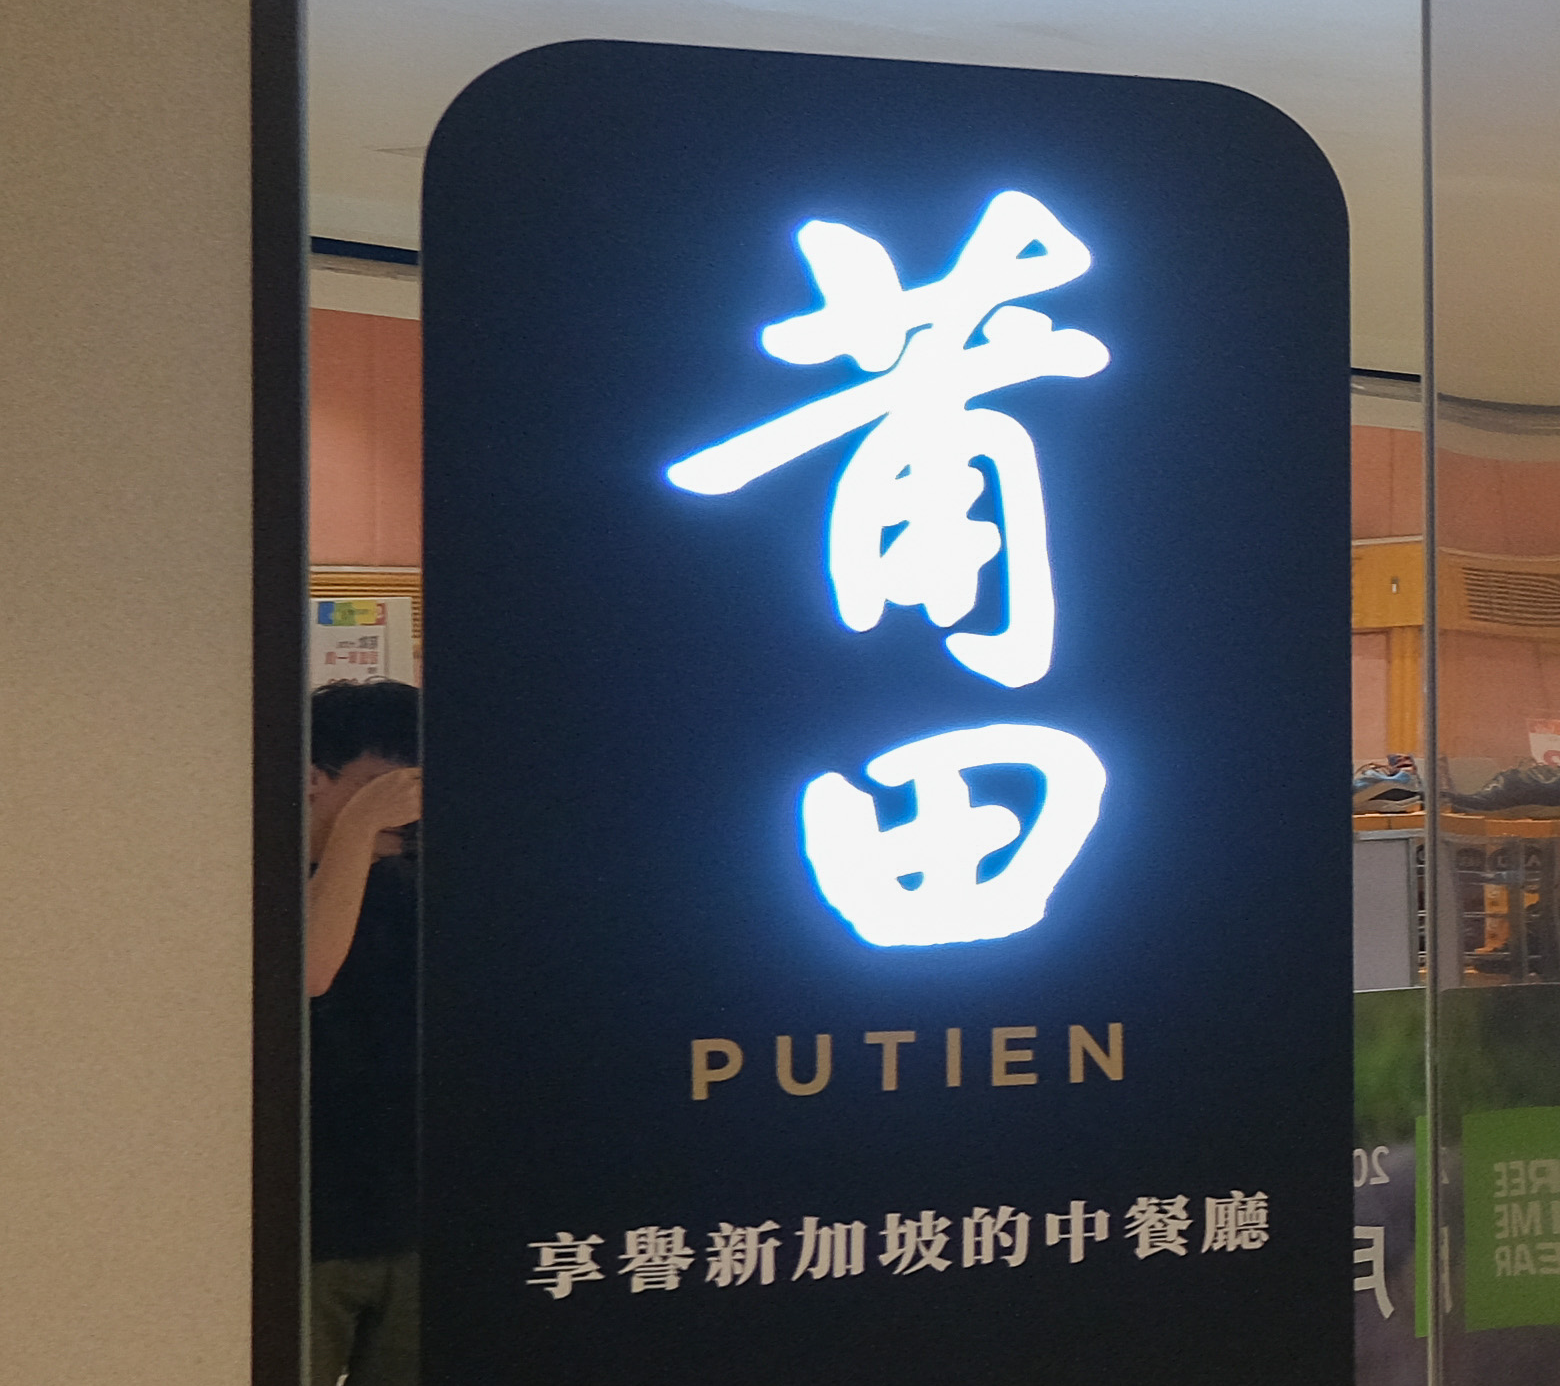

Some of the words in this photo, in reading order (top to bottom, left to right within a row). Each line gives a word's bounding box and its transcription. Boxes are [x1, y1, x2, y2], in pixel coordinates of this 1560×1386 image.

[666, 190, 1110, 948] 莆田
[690, 1019, 1128, 1101] PUTIEN
[525, 1188, 1271, 1299] 享譽新加坡的中餐廳
